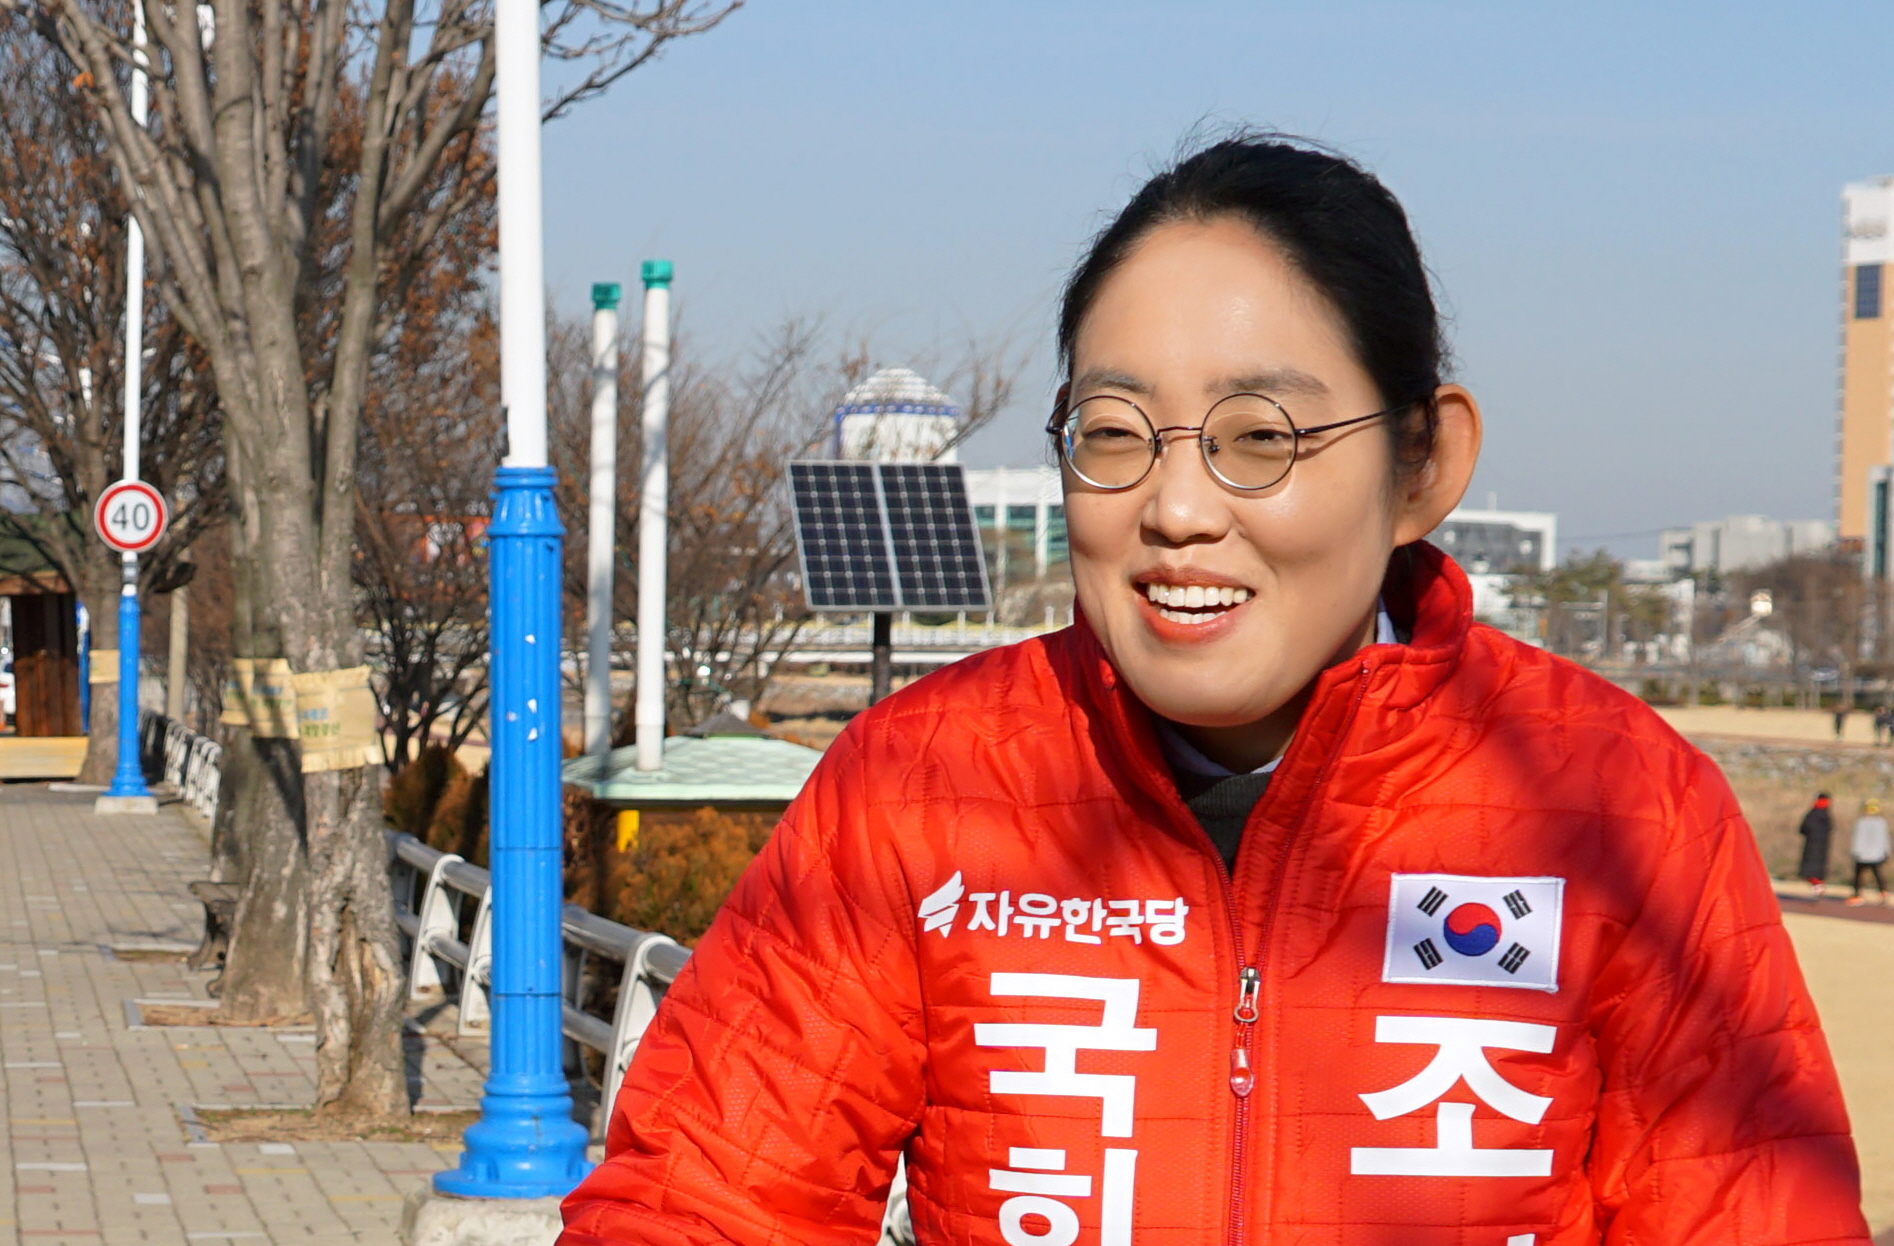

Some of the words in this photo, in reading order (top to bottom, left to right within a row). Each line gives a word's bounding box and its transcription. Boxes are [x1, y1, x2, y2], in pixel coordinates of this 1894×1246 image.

[111, 503, 150, 531] 40
[966, 890, 1190, 946] 자유한국당
[1350, 1015, 1557, 1246] 조
